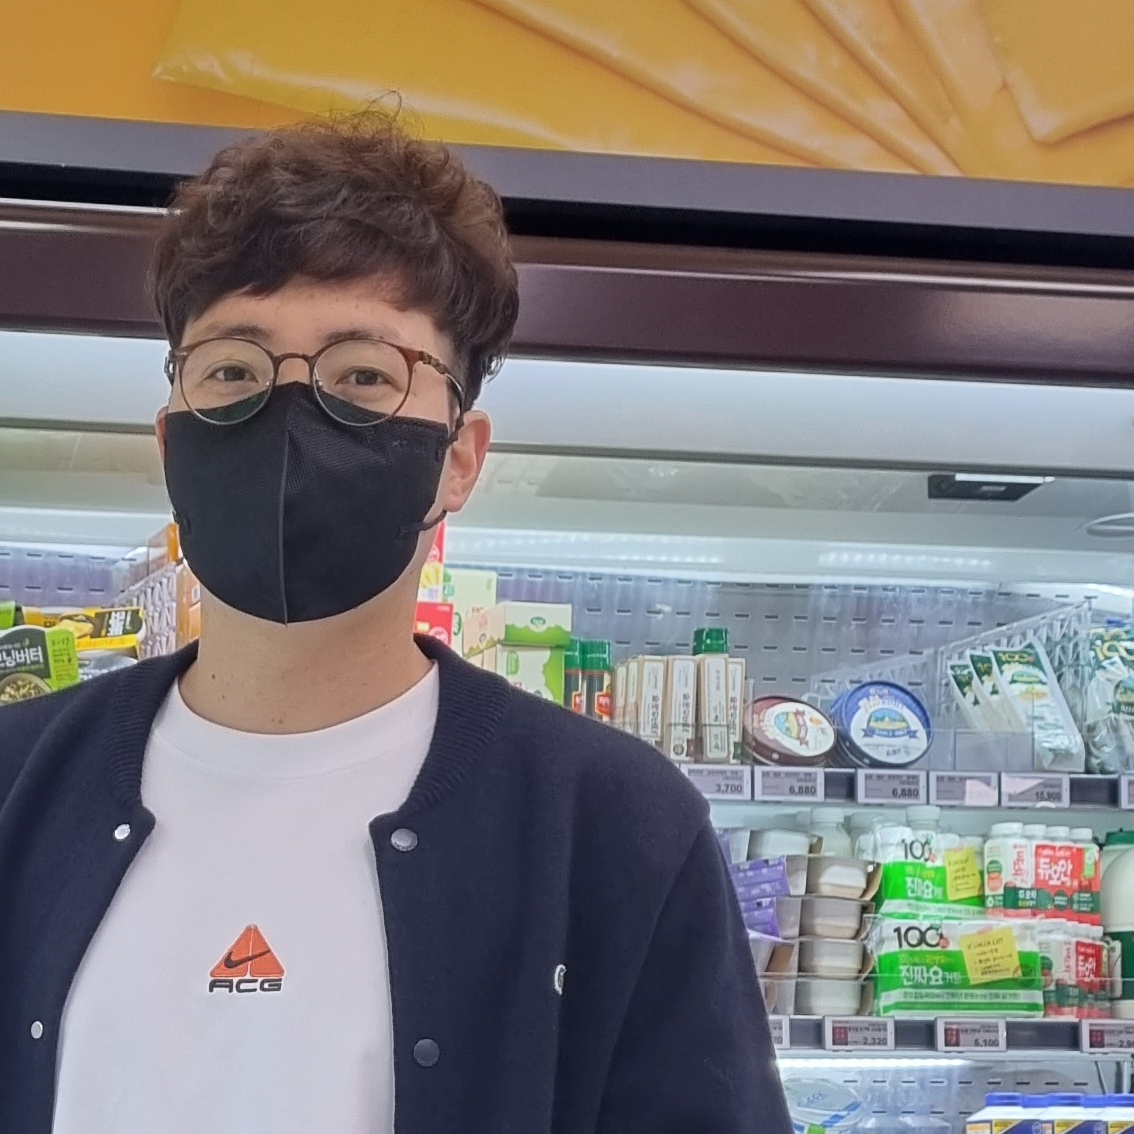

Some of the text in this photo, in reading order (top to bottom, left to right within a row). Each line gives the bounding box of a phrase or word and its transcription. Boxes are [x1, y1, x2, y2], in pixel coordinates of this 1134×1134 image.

[789, 785, 817, 795] 6,880
[892, 788, 919, 797] 6,880
[900, 966, 962, 985] 진짜요거트
[208, 978, 283, 993] ACG
